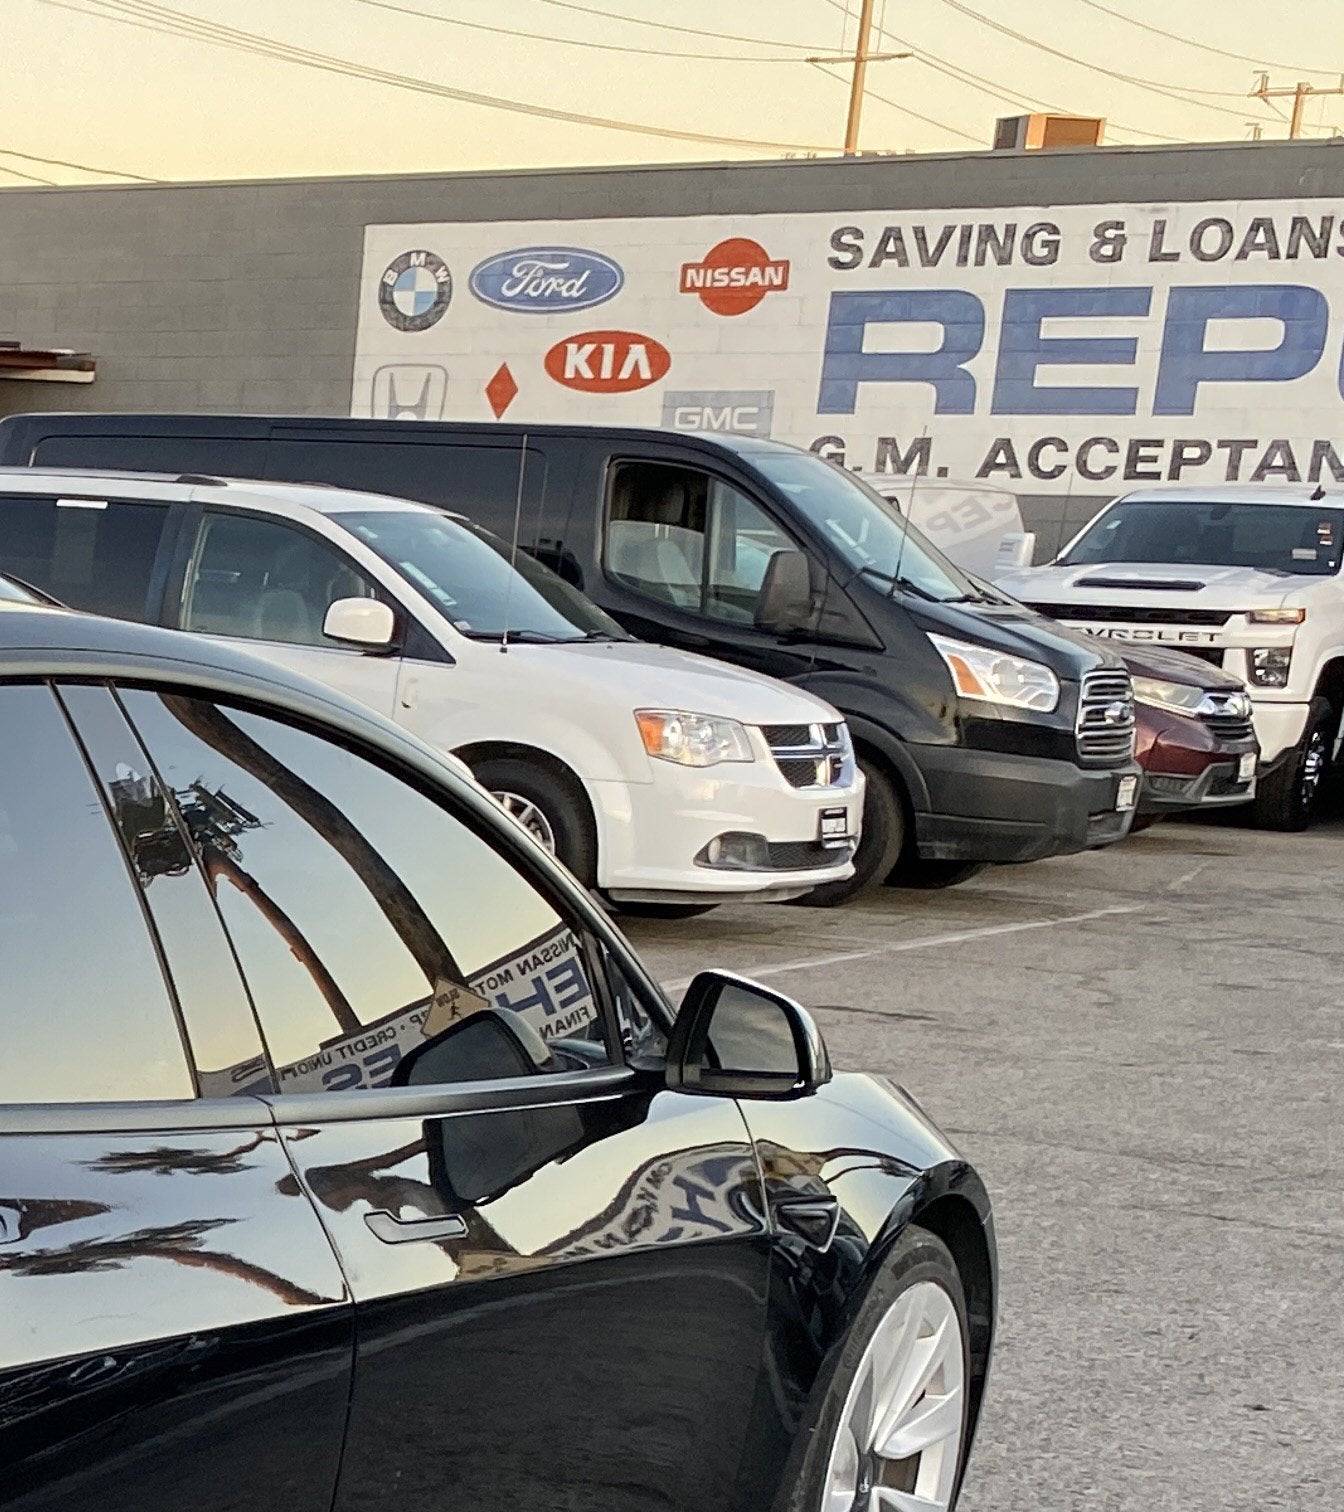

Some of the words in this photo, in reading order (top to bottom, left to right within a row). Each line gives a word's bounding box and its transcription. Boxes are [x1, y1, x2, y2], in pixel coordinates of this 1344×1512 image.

[827, 221, 1061, 271] SAVING
[1089, 219, 1127, 263] &
[1149, 215, 1344, 263] LOAN
[501, 261, 592, 298] Ford
[685, 266, 785, 288] NISSAN
[565, 343, 654, 380] KIA
[817, 284, 1344, 416] REP
[674, 407, 759, 430] GMC
